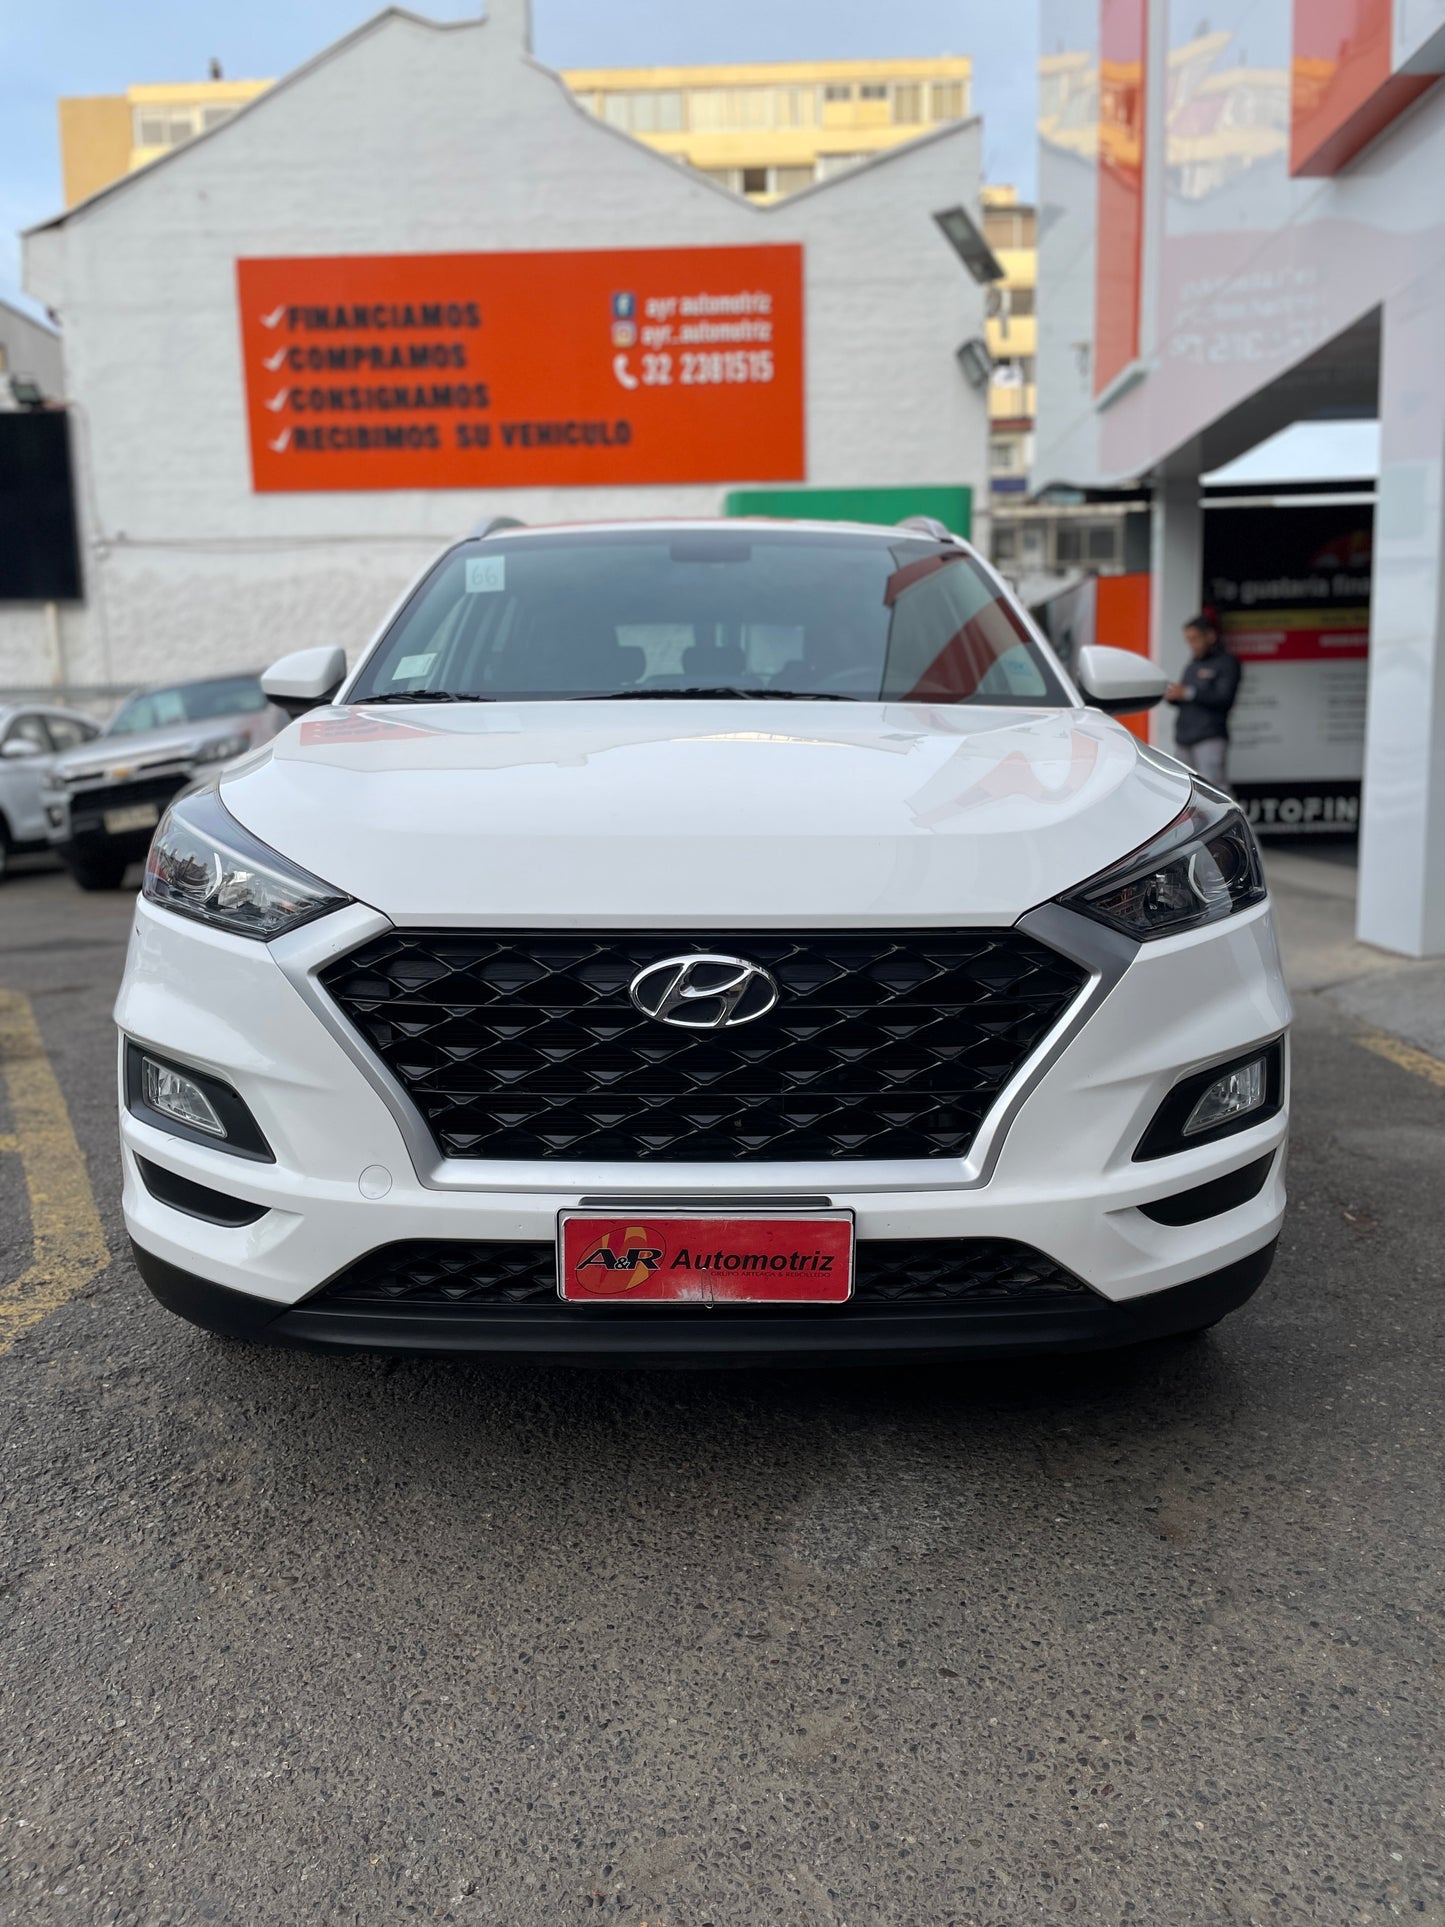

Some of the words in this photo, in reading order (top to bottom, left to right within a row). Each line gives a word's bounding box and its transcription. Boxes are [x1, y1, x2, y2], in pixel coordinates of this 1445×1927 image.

[287, 302, 480, 332] FINANCIAMOS
[646, 296, 676, 321] ayr
[680, 291, 772, 316] automotriz
[289, 343, 466, 371] COMPRAMOS
[642, 352, 673, 385] 32
[290, 383, 490, 411] CONSIGNAMOS
[294, 424, 440, 450] RECIBIMOS
[457, 424, 490, 447] SU
[503, 420, 632, 447] VEHICULO
[472, 565, 497, 586] 66
[1240, 796, 1358, 823] UTOFIN
[575, 1248, 663, 1270] A&R
[670, 1249, 835, 1271] Automotriz
